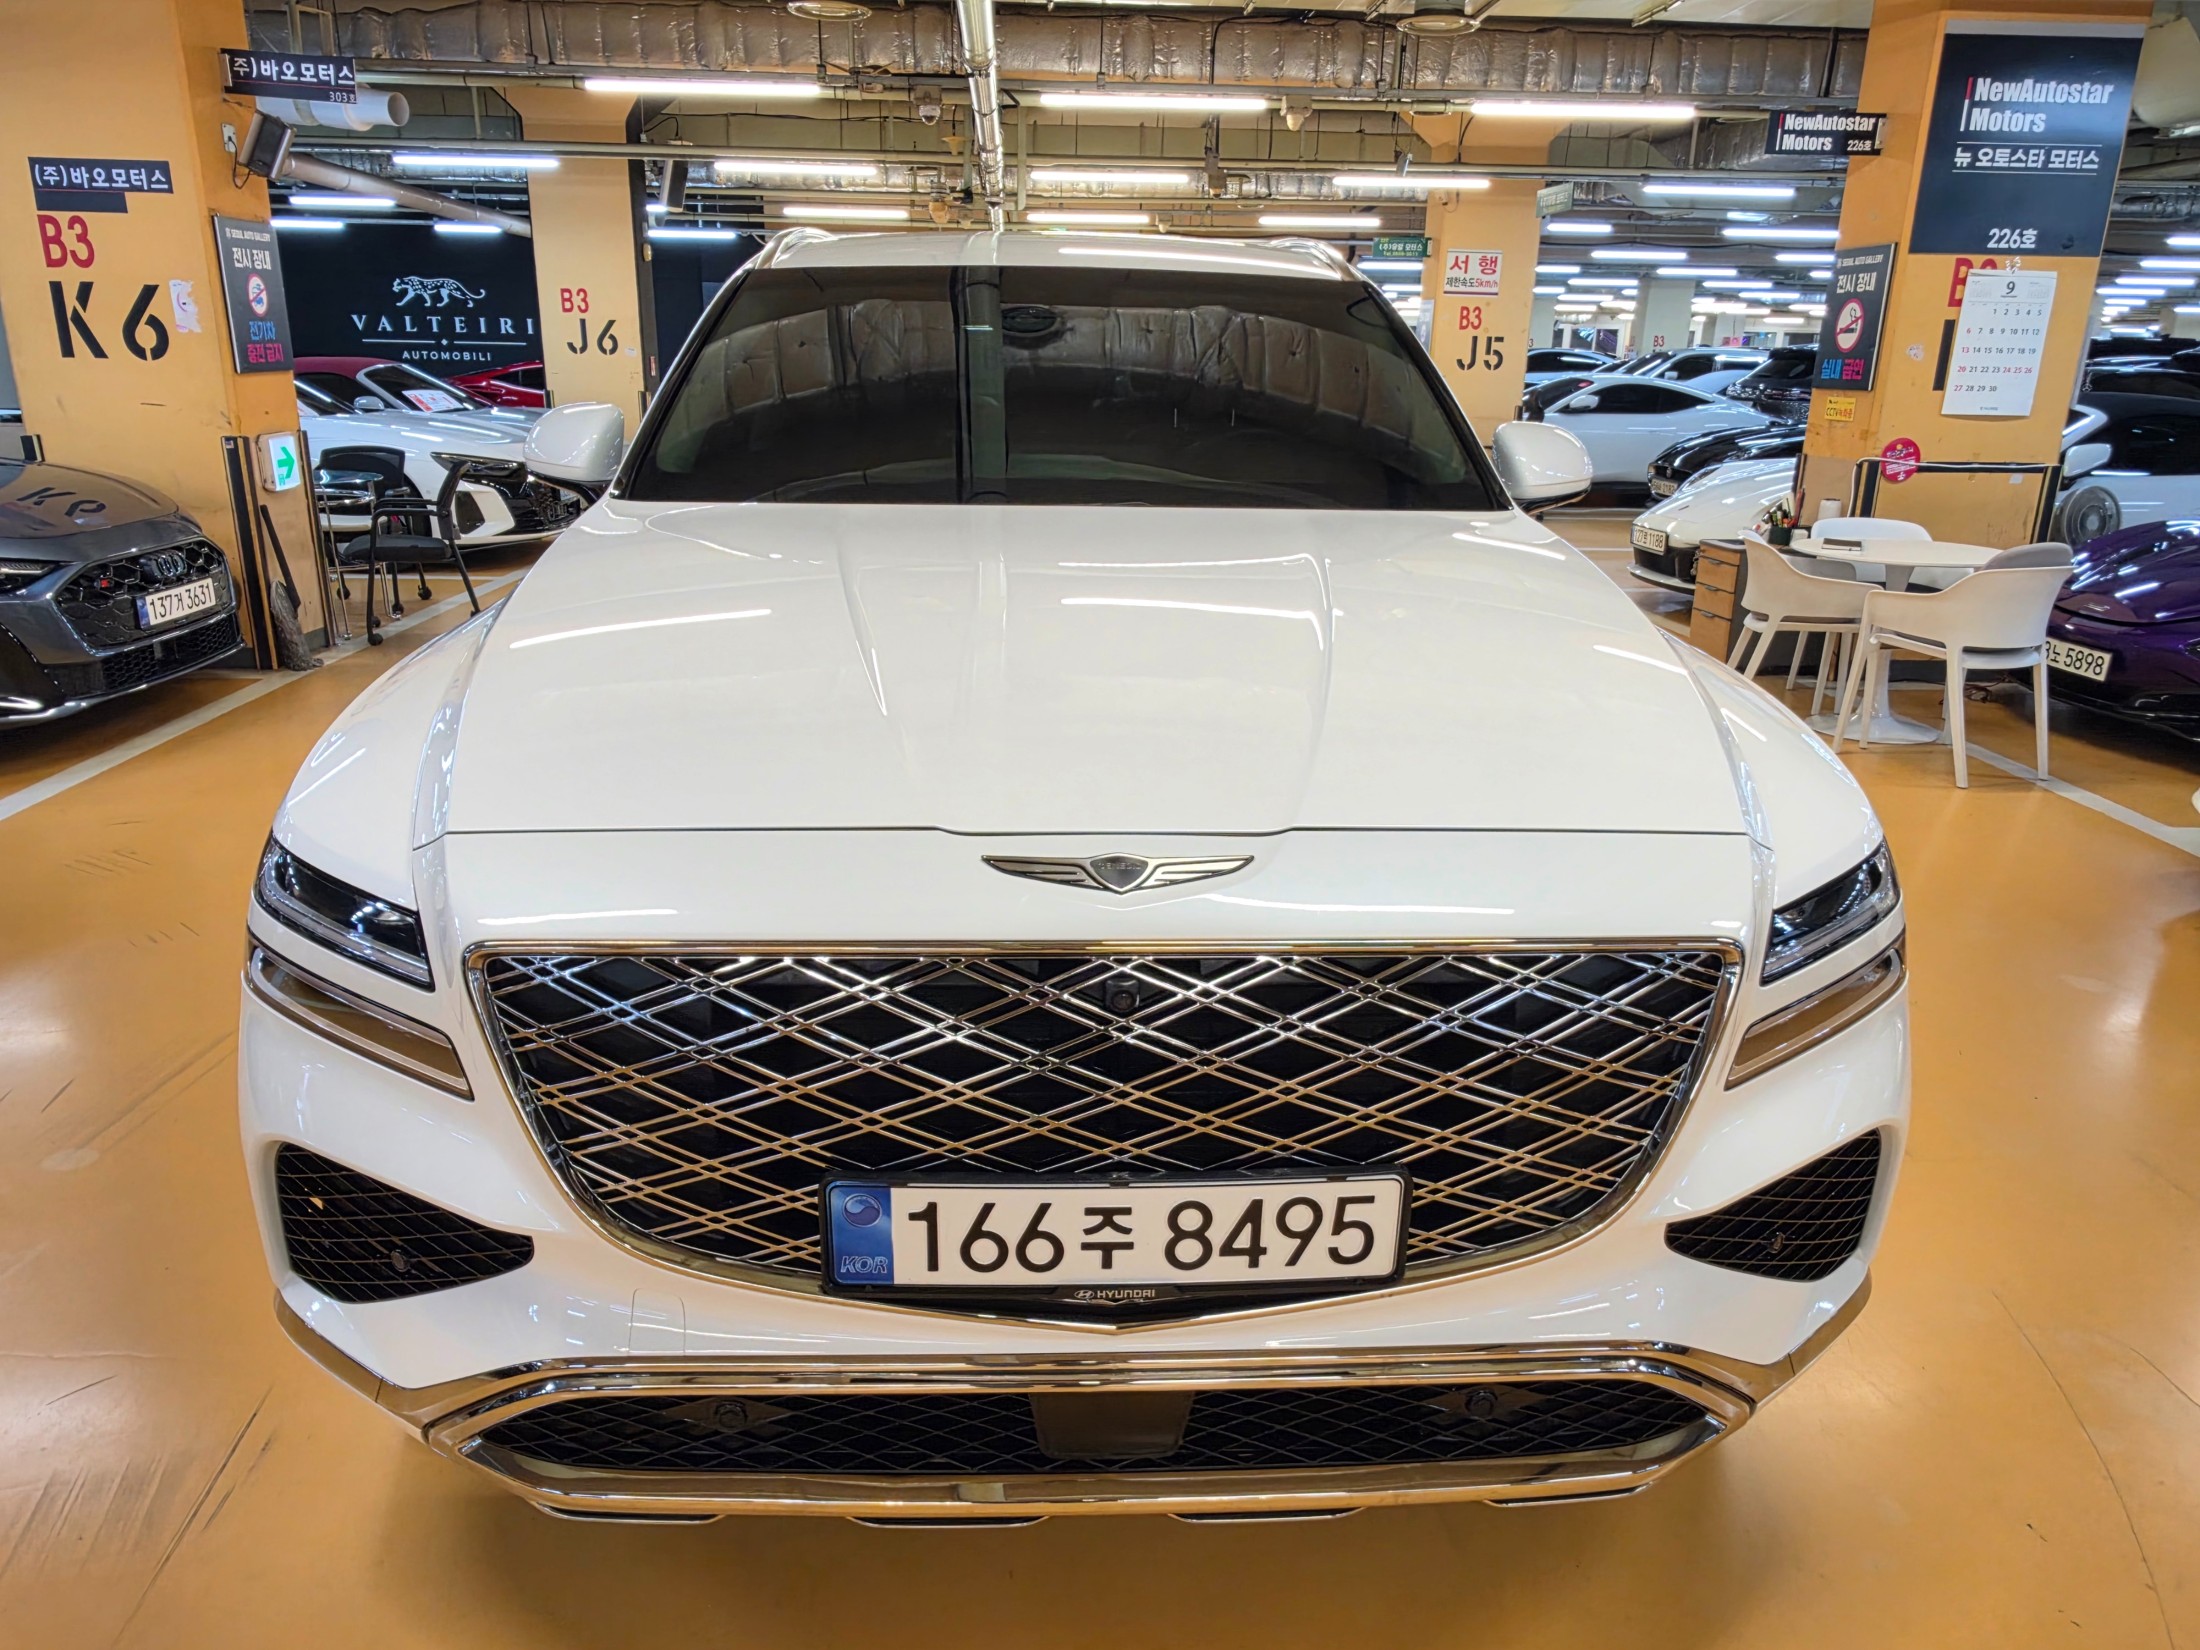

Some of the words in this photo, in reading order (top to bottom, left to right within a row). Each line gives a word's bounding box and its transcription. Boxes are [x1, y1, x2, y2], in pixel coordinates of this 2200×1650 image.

[233, 57, 355, 86] 주)바오모터스
[1973, 78, 2114, 104] NewAutostar
[1784, 113, 1876, 131] NewAutostar
[1969, 108, 2046, 133] Motors
[1781, 134, 1833, 151] Motors
[1847, 140, 1873, 151] 226호
[1954, 147, 1971, 167] 뉴
[1975, 148, 2045, 168] 오토스타
[2048, 150, 2100, 169] 모터스
[34, 164, 169, 190] (주)바오모터스
[37, 214, 95, 269] B3
[1987, 228, 2039, 248] 226호
[232, 247, 252, 269] 전시
[1836, 274, 1855, 294] 전시
[2006, 281, 2016, 295] 9
[560, 287, 590, 313] B3
[351, 314, 535, 335] VALTEIRI
[1458, 306, 1482, 330] B3
[1653, 336, 1665, 347] B3
[402, 351, 492, 361] AUTOMOBILI
[1456, 335, 1505, 371] J5
[1821, 358, 1842, 379] 실내
[149, 593, 185, 620] 137거
[185, 582, 213, 609] 3631
[2064, 647, 2105, 676] 5898
[908, 1201, 1136, 1273] 166주
[1163, 1194, 1377, 1270] 8495
[840, 1255, 888, 1274] KOR
[1097, 1289, 1155, 1298] HYUNDAI
